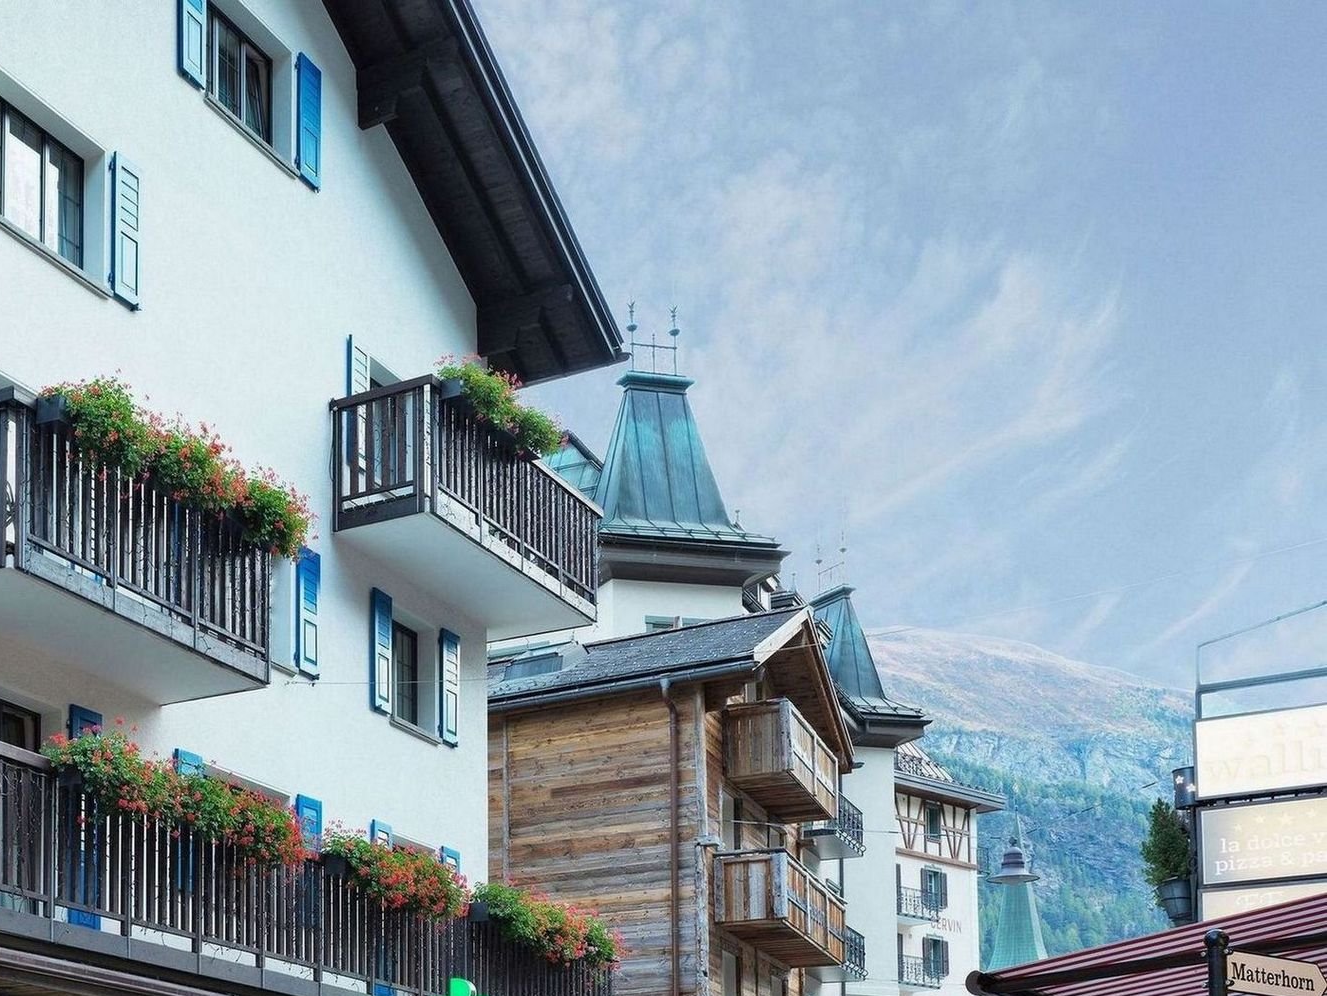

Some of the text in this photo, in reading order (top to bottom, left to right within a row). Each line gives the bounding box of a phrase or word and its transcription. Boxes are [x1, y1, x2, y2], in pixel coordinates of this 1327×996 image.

[1219, 838, 1240, 853] la
[1247, 832, 1306, 851] dolce
[1214, 855, 1273, 875] pizza
[1281, 851, 1294, 866] &
[1231, 962, 1315, 991] Matterhorn
